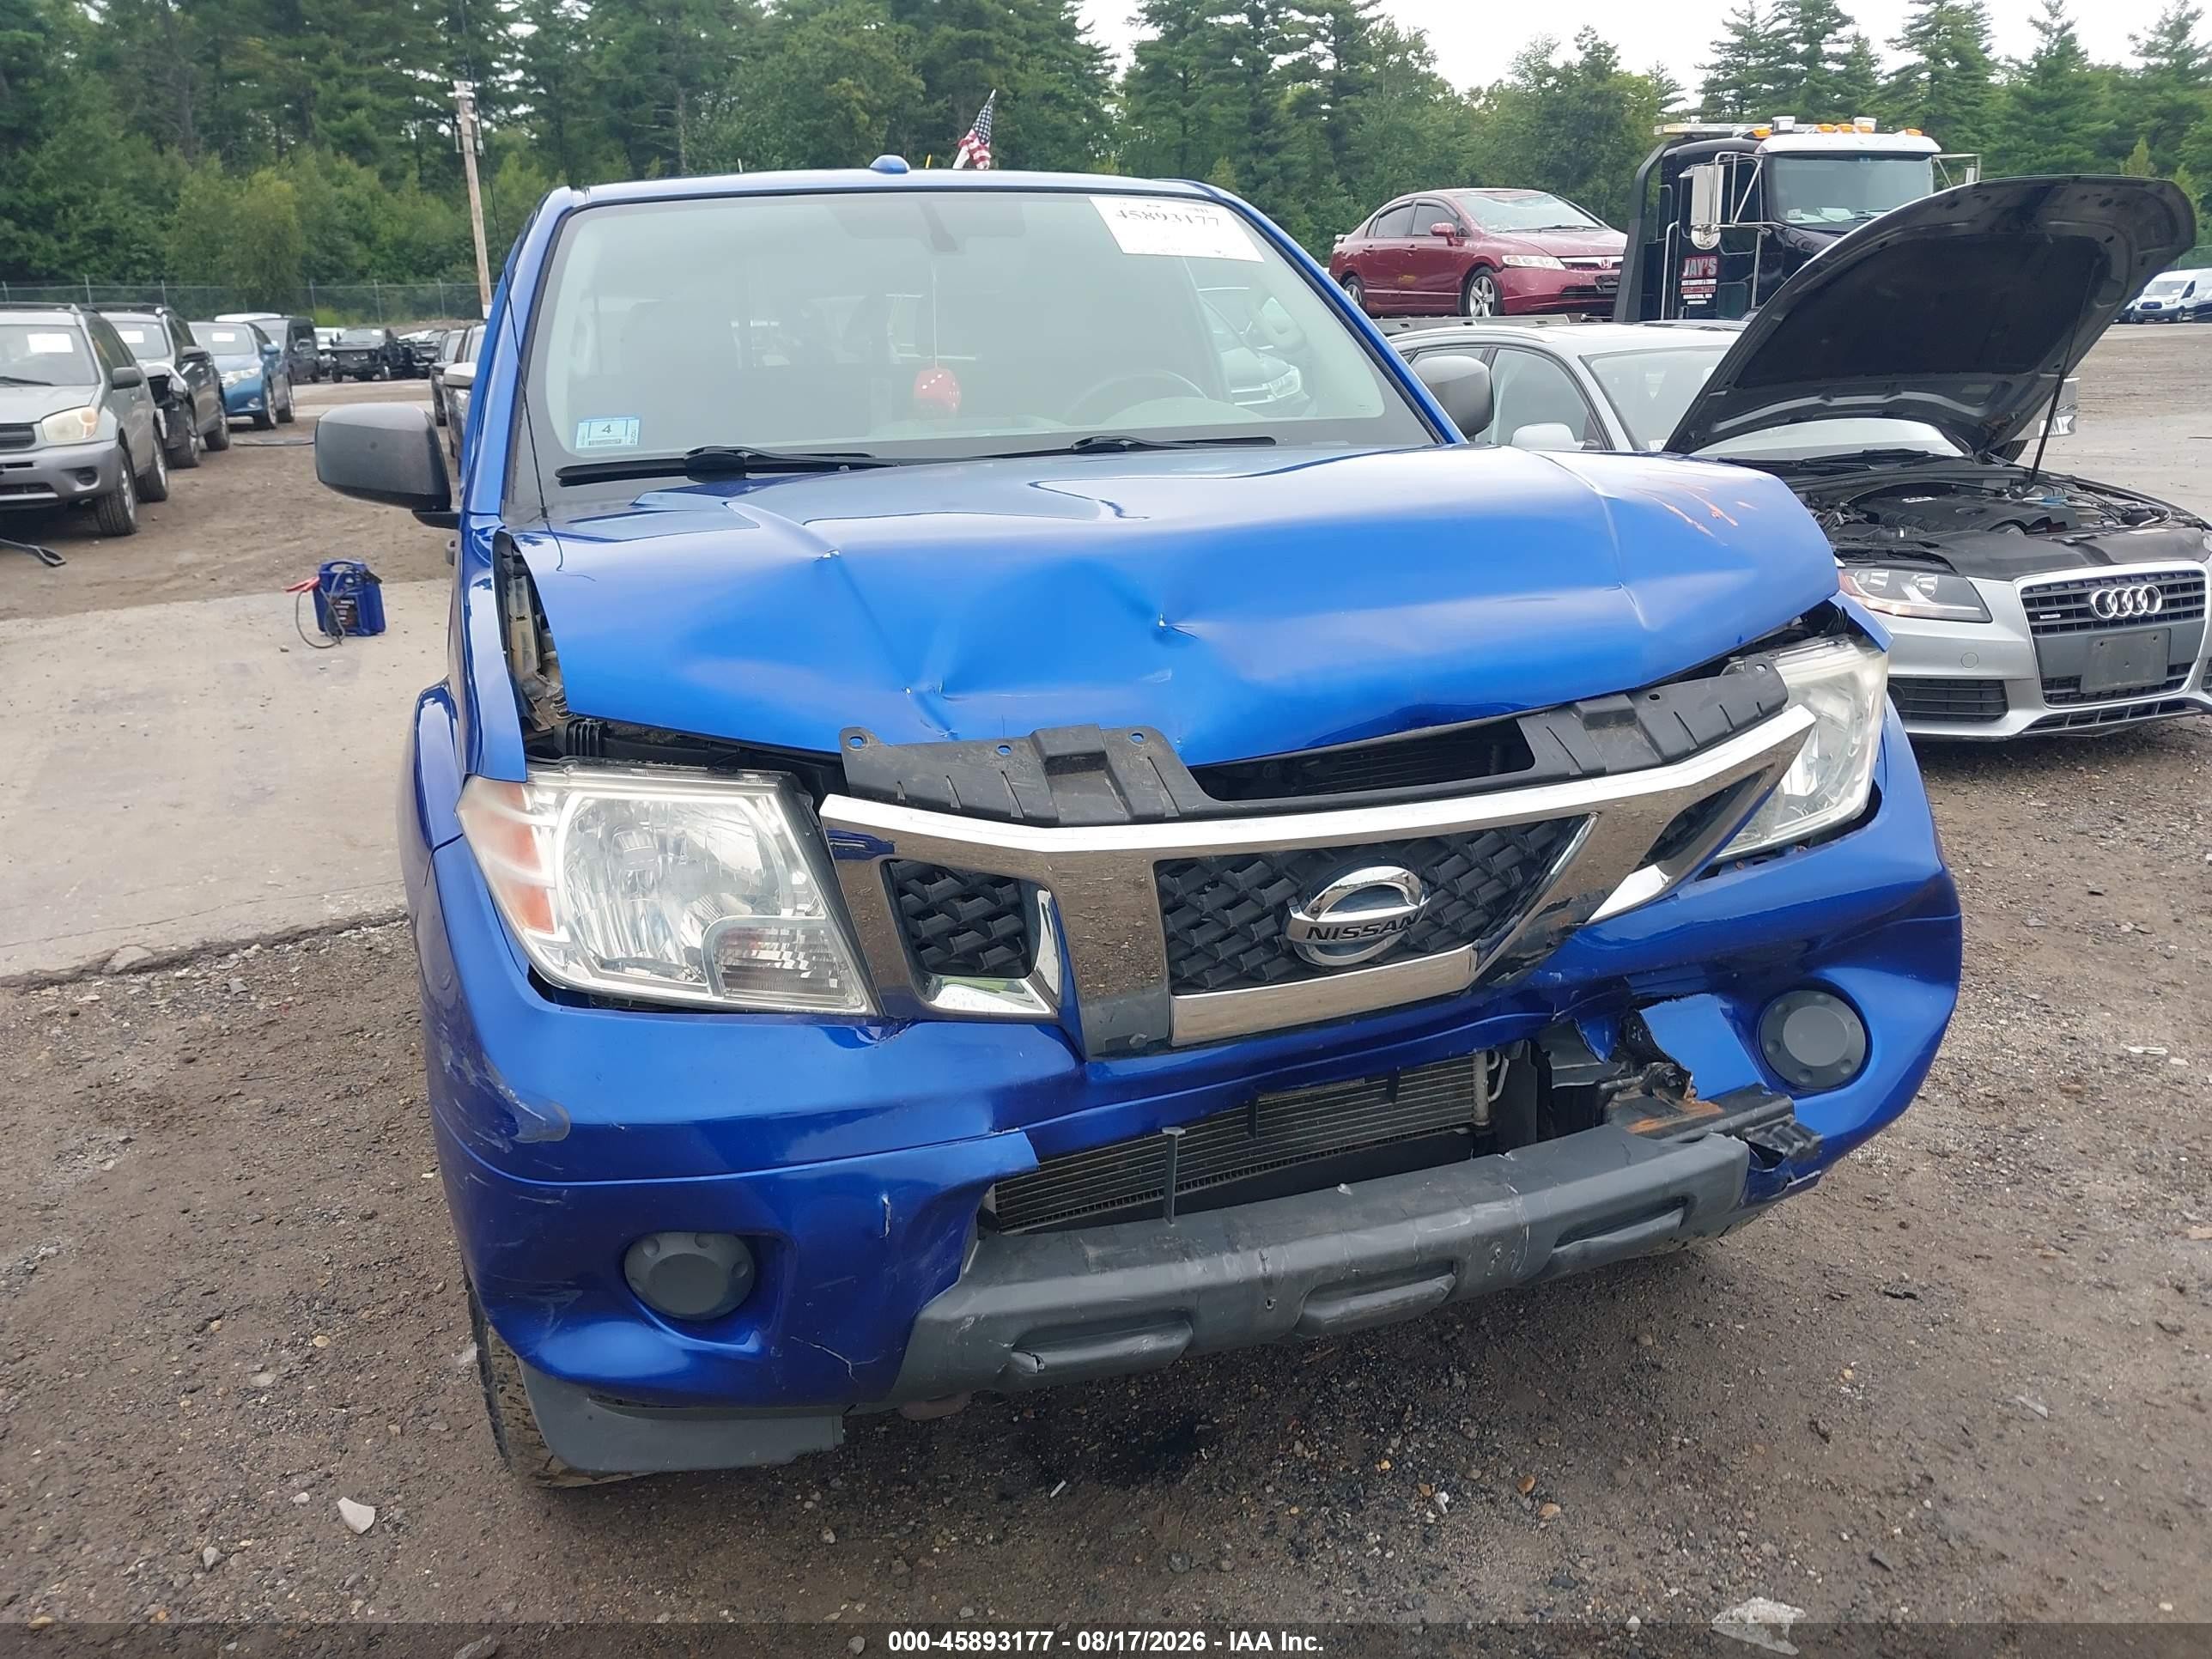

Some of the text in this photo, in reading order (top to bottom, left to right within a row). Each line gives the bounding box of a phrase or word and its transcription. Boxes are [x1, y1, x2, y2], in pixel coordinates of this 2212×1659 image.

[1117, 210, 1219, 227] 45893177
[1682, 258, 1717, 277] JAY'S
[601, 423, 612, 434] 4
[1306, 912, 1419, 941] NISSAN
